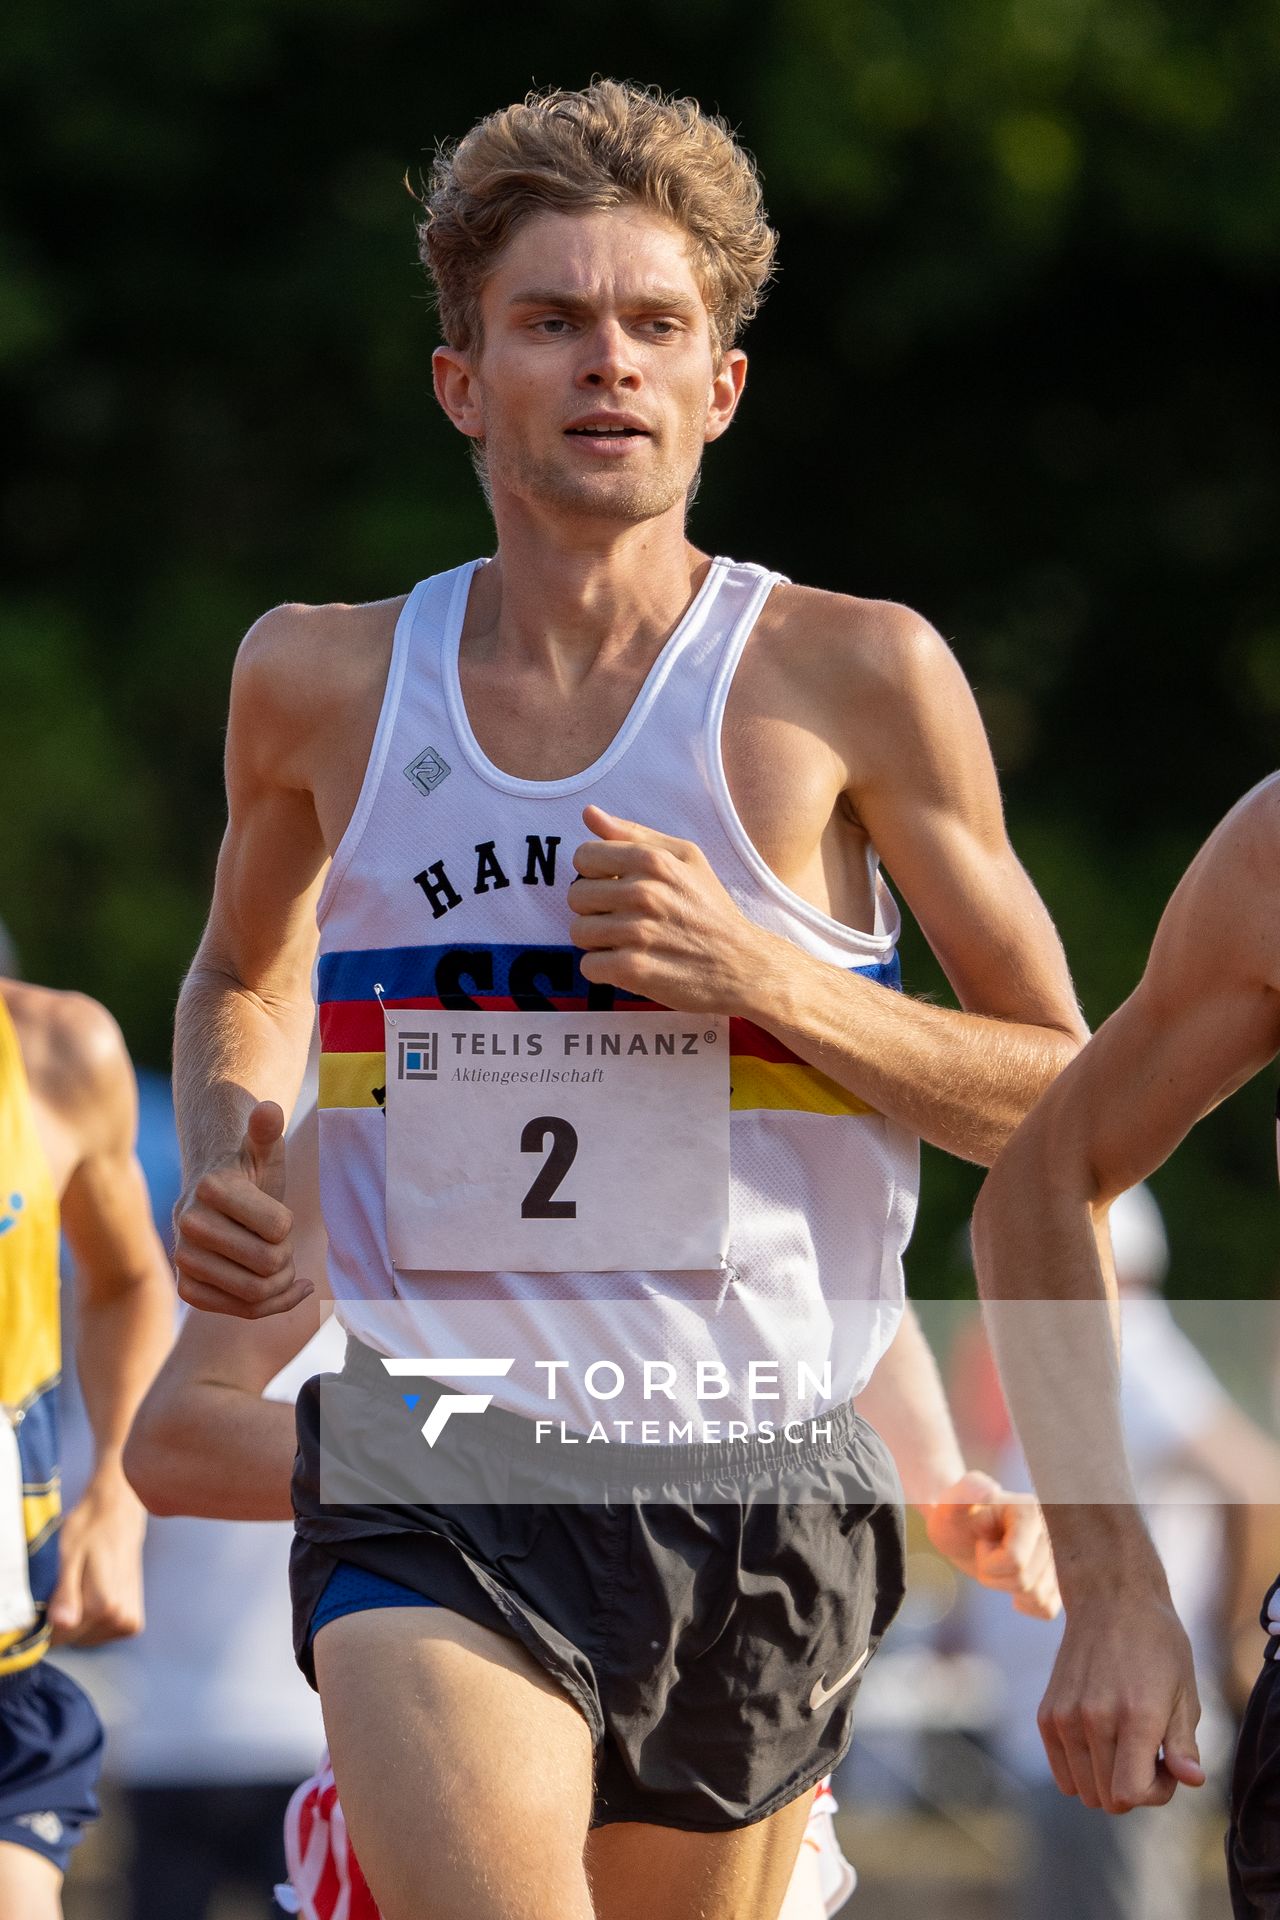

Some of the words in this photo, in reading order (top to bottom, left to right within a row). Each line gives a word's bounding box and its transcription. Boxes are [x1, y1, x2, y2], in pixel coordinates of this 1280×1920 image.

[413, 835, 584, 919] HAN
[435, 951, 615, 1011] SS
[451, 1033, 543, 1055] TELIS
[451, 1068, 604, 1085] Aktiengesellschaft
[520, 1115, 579, 1219] 2
